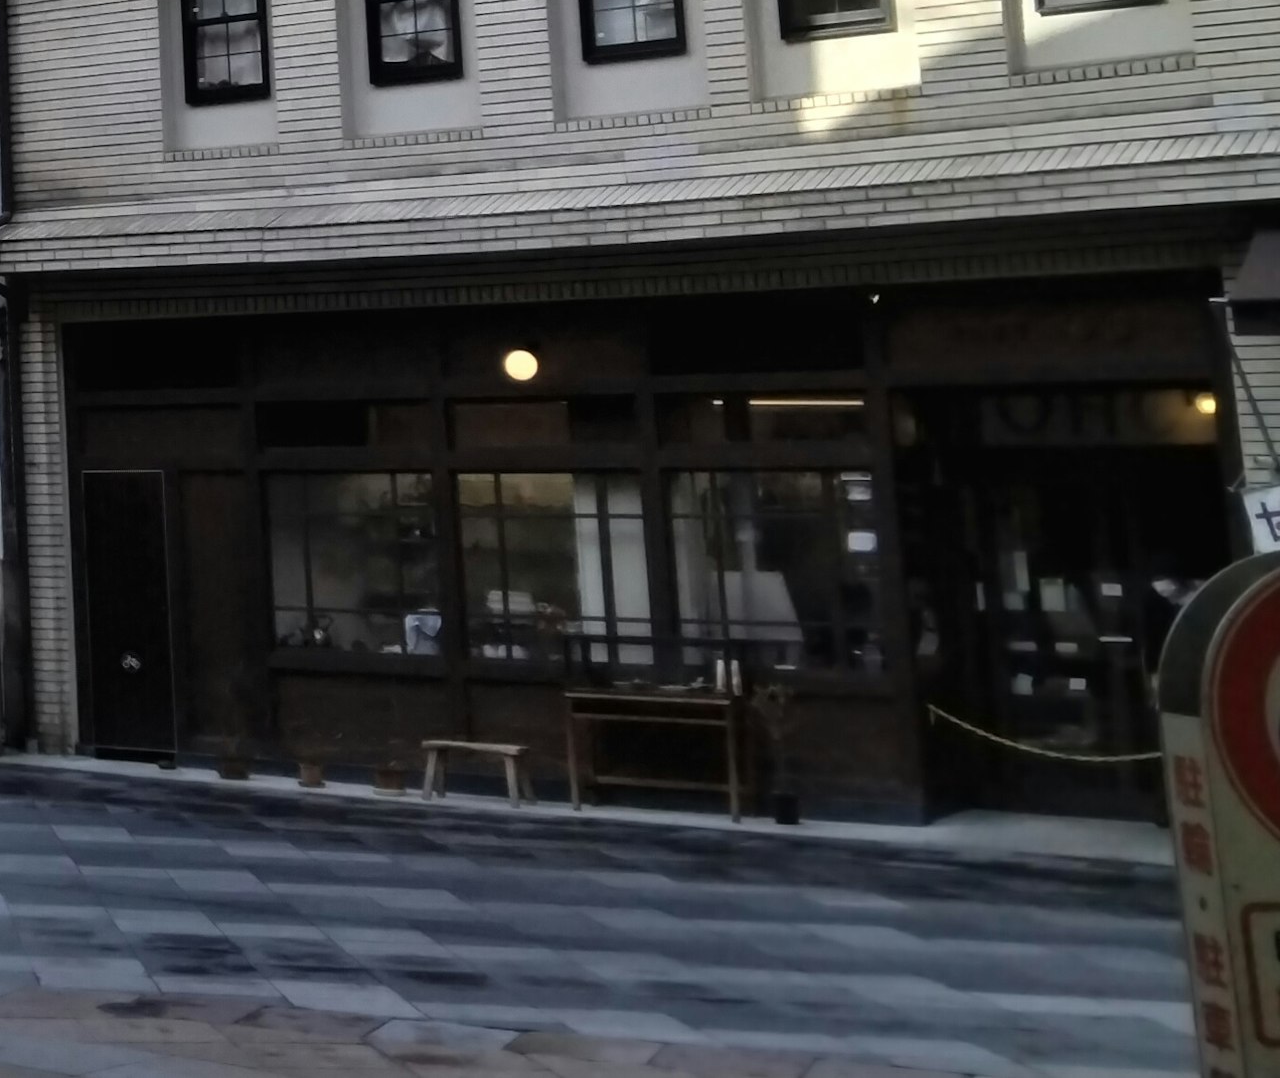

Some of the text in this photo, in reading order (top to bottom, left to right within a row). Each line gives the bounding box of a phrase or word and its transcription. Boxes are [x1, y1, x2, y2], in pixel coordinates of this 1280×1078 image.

[1173, 755, 1234, 1078] 駐輪・駐車
